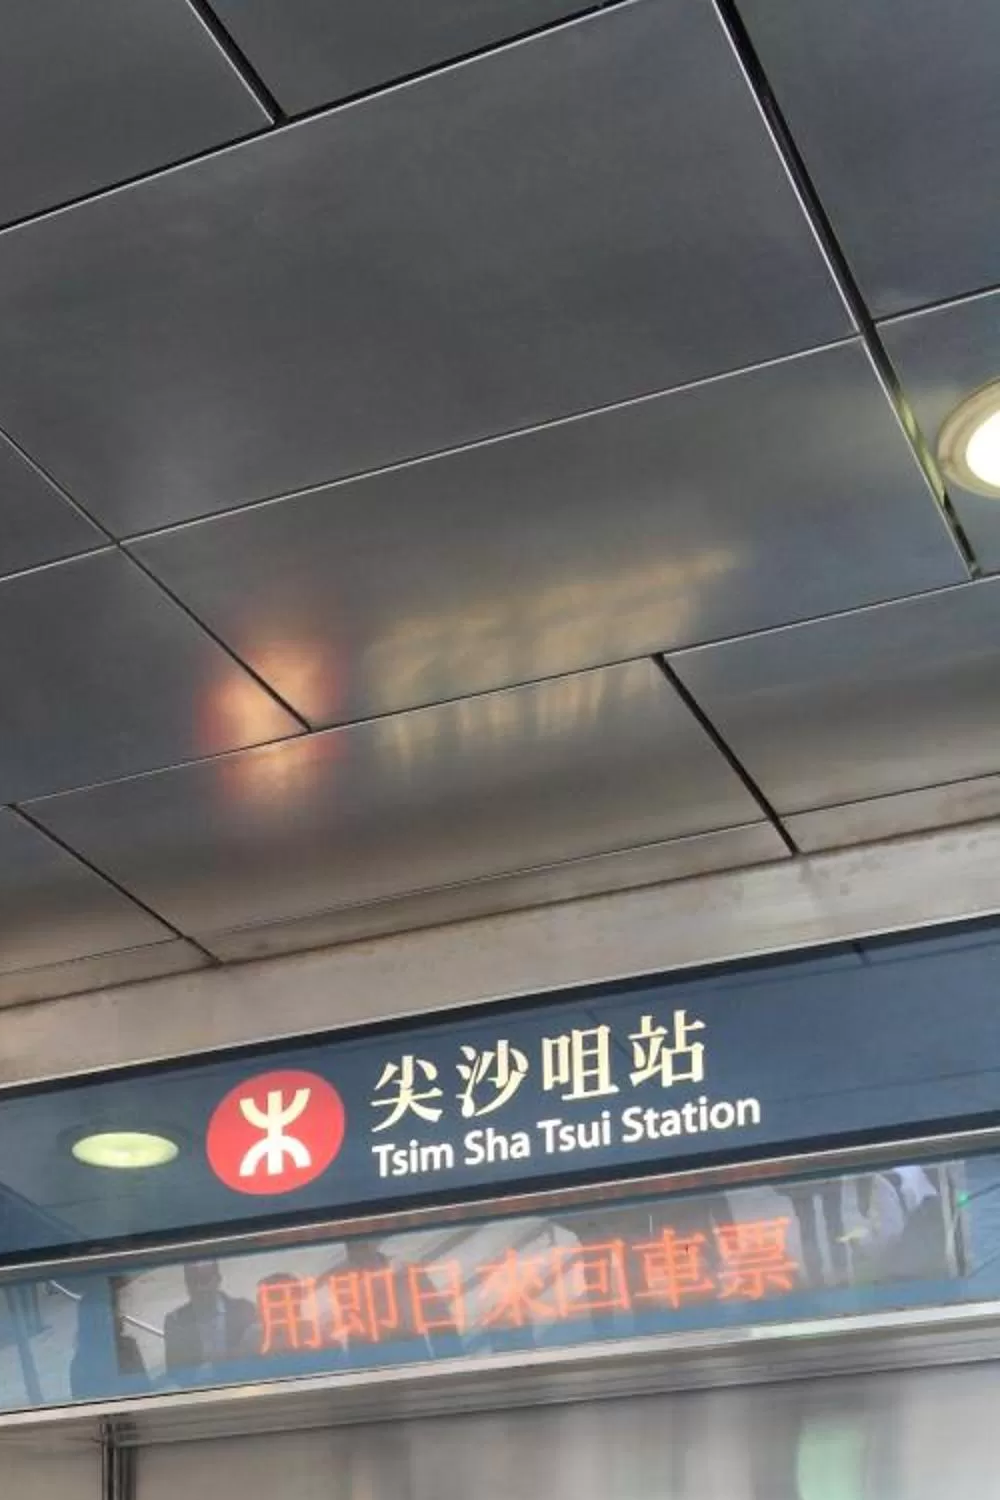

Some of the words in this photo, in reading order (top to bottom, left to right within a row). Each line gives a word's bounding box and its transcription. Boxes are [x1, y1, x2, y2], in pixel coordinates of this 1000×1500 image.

[370, 1009, 707, 1133] 尖沙咀站
[371, 1139, 454, 1178] Tsim
[463, 1127, 531, 1164] Sha
[537, 1111, 611, 1154] Tsui
[621, 1097, 761, 1143] Station
[258, 1217, 798, 1354] 用即日來回車票
